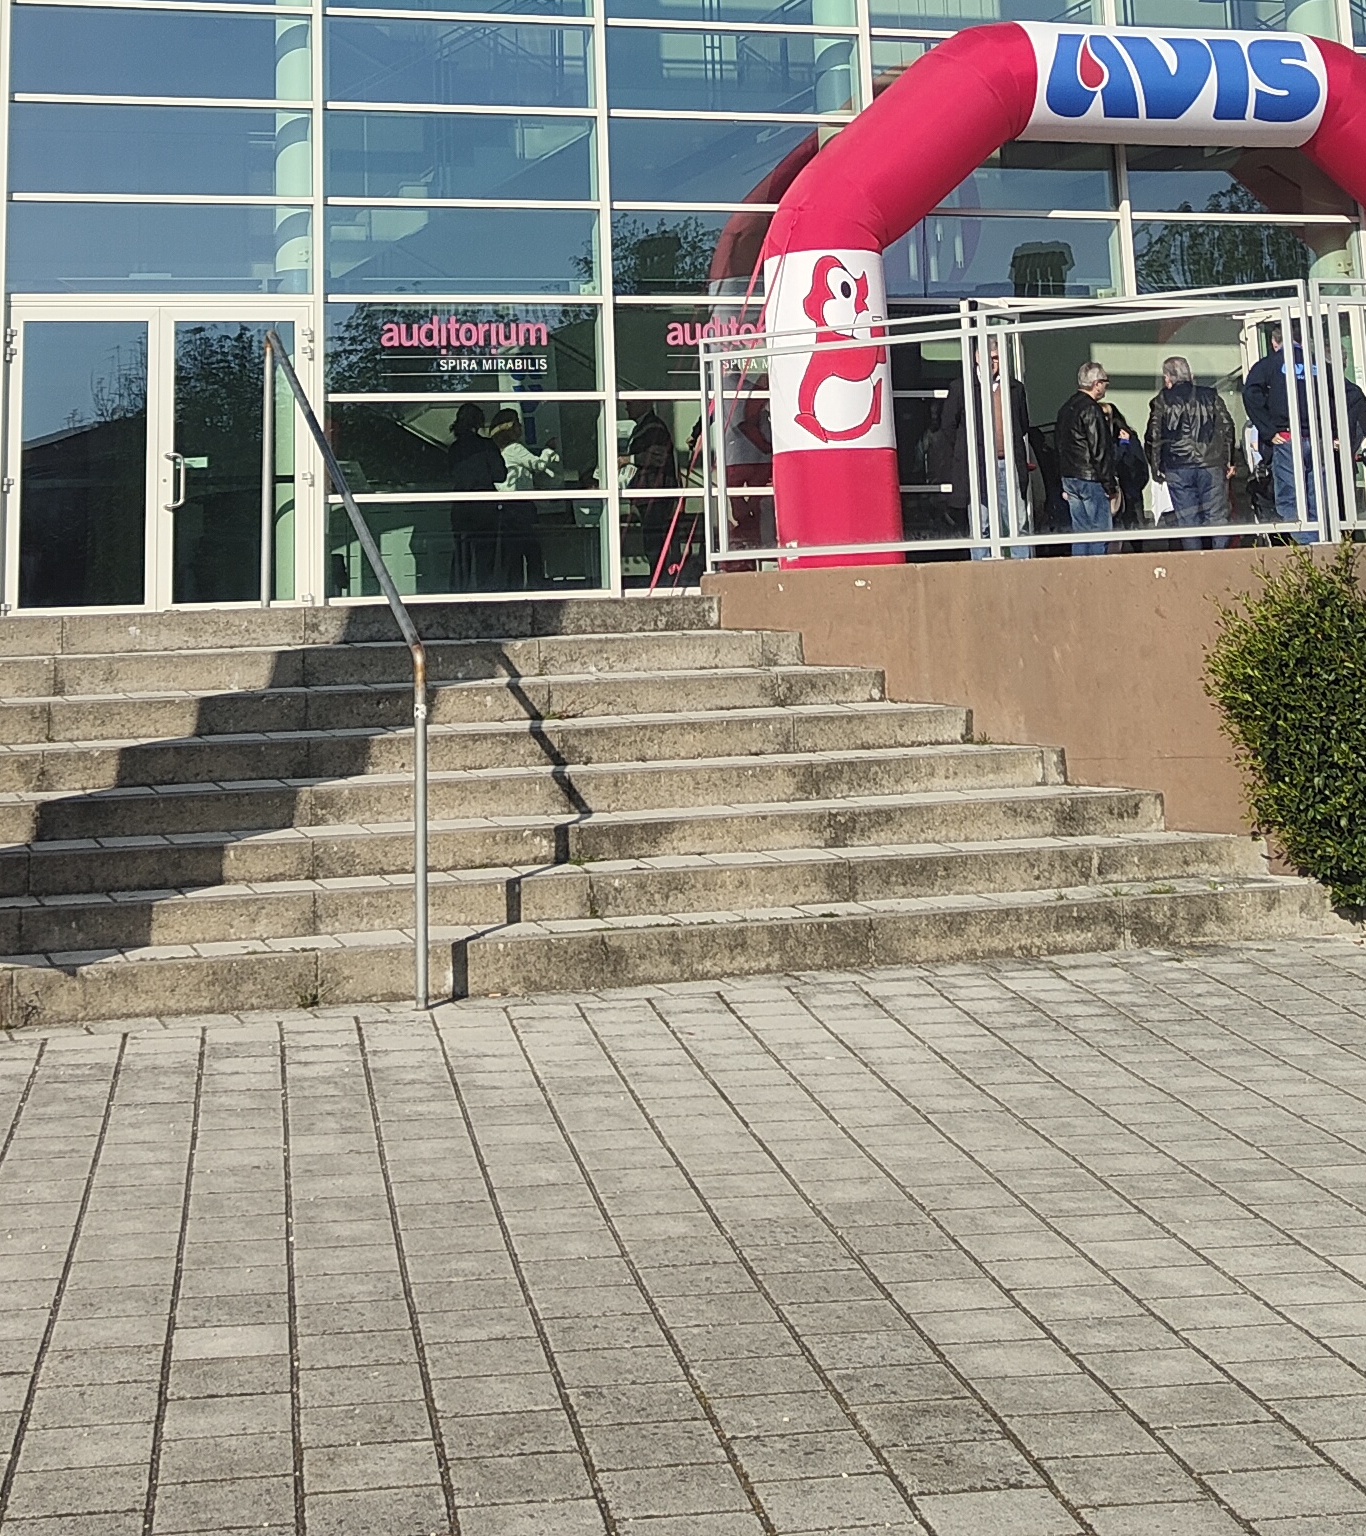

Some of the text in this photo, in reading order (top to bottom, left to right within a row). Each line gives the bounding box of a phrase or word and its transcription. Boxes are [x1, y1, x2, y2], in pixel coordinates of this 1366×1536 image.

[1046, 33, 1321, 122] AVIS
[380, 315, 549, 355] auditorium
[439, 358, 548, 371] SPIRA MIRABILIS
